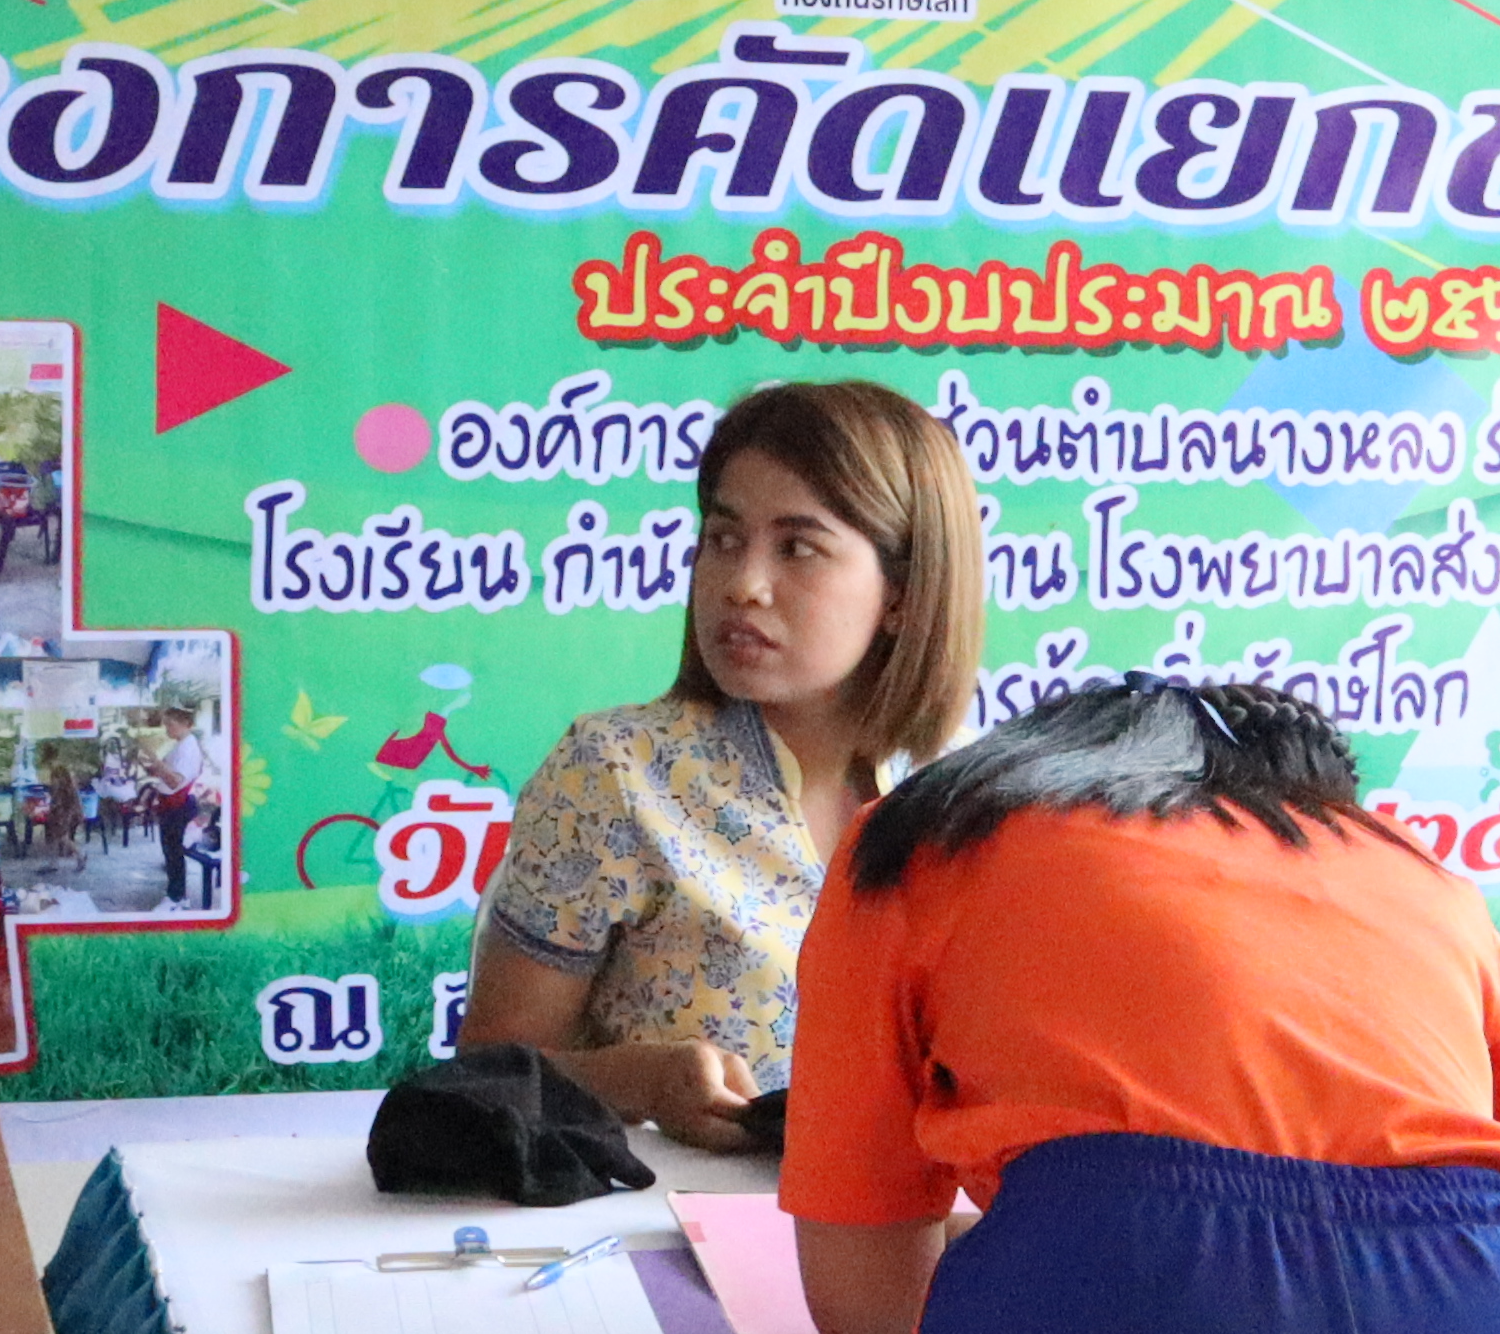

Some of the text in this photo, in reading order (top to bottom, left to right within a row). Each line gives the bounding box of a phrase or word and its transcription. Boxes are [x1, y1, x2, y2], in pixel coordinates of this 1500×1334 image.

[585, 239, 1331, 335] ประจำปีงบประมาณ
[258, 492, 519, 600] โรงเรียน
[553, 512, 698, 603] กำนั
[269, 986, 369, 1051] ณ
